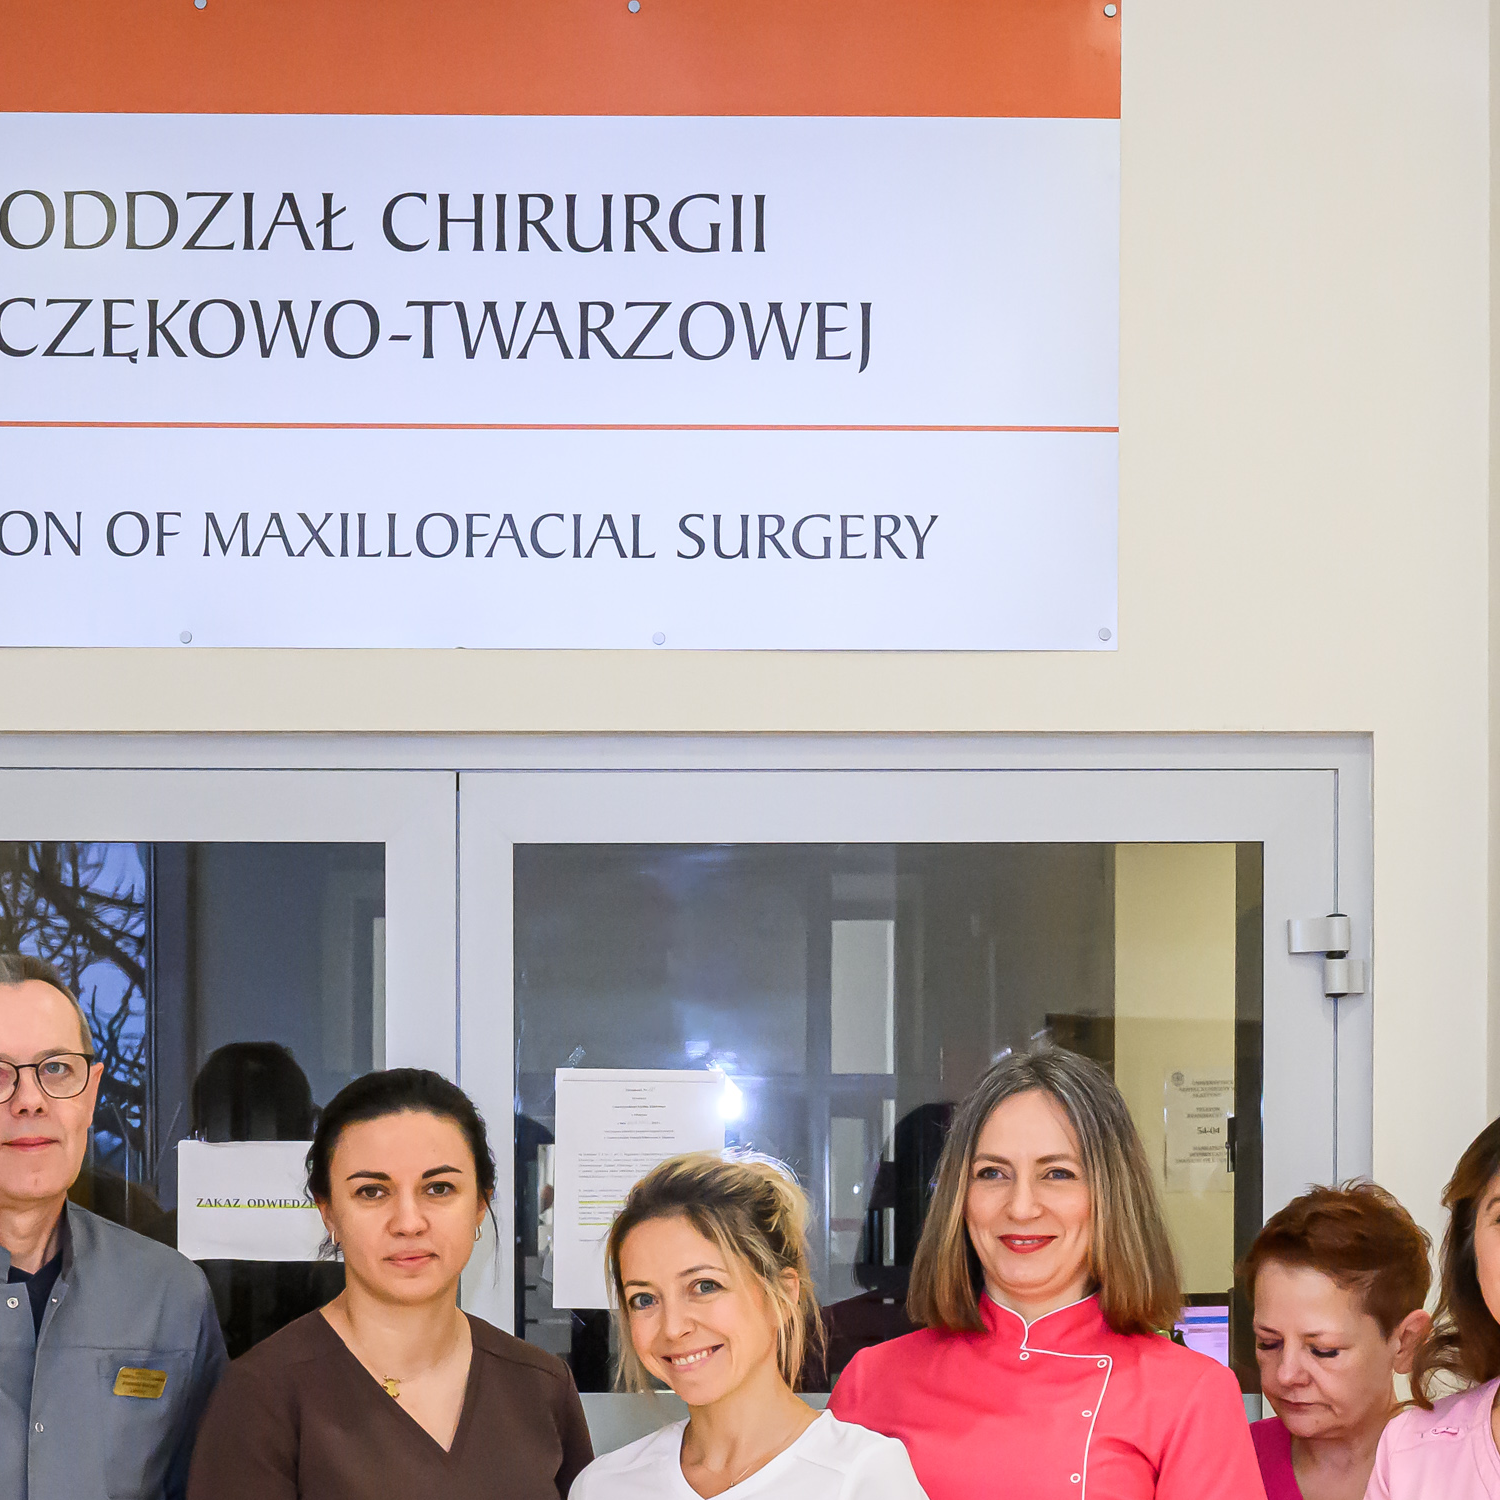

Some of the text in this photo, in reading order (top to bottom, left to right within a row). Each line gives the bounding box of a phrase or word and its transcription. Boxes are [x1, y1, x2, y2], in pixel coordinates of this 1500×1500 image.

[382, 192, 767, 254] CHIRURGII
[105, 511, 182, 557] OF
[202, 512, 656, 559] MAXILLOFACIAL
[677, 513, 940, 560] SURGERY
[196, 1198, 316, 1208] ZAKAZ ODWIEDZI
